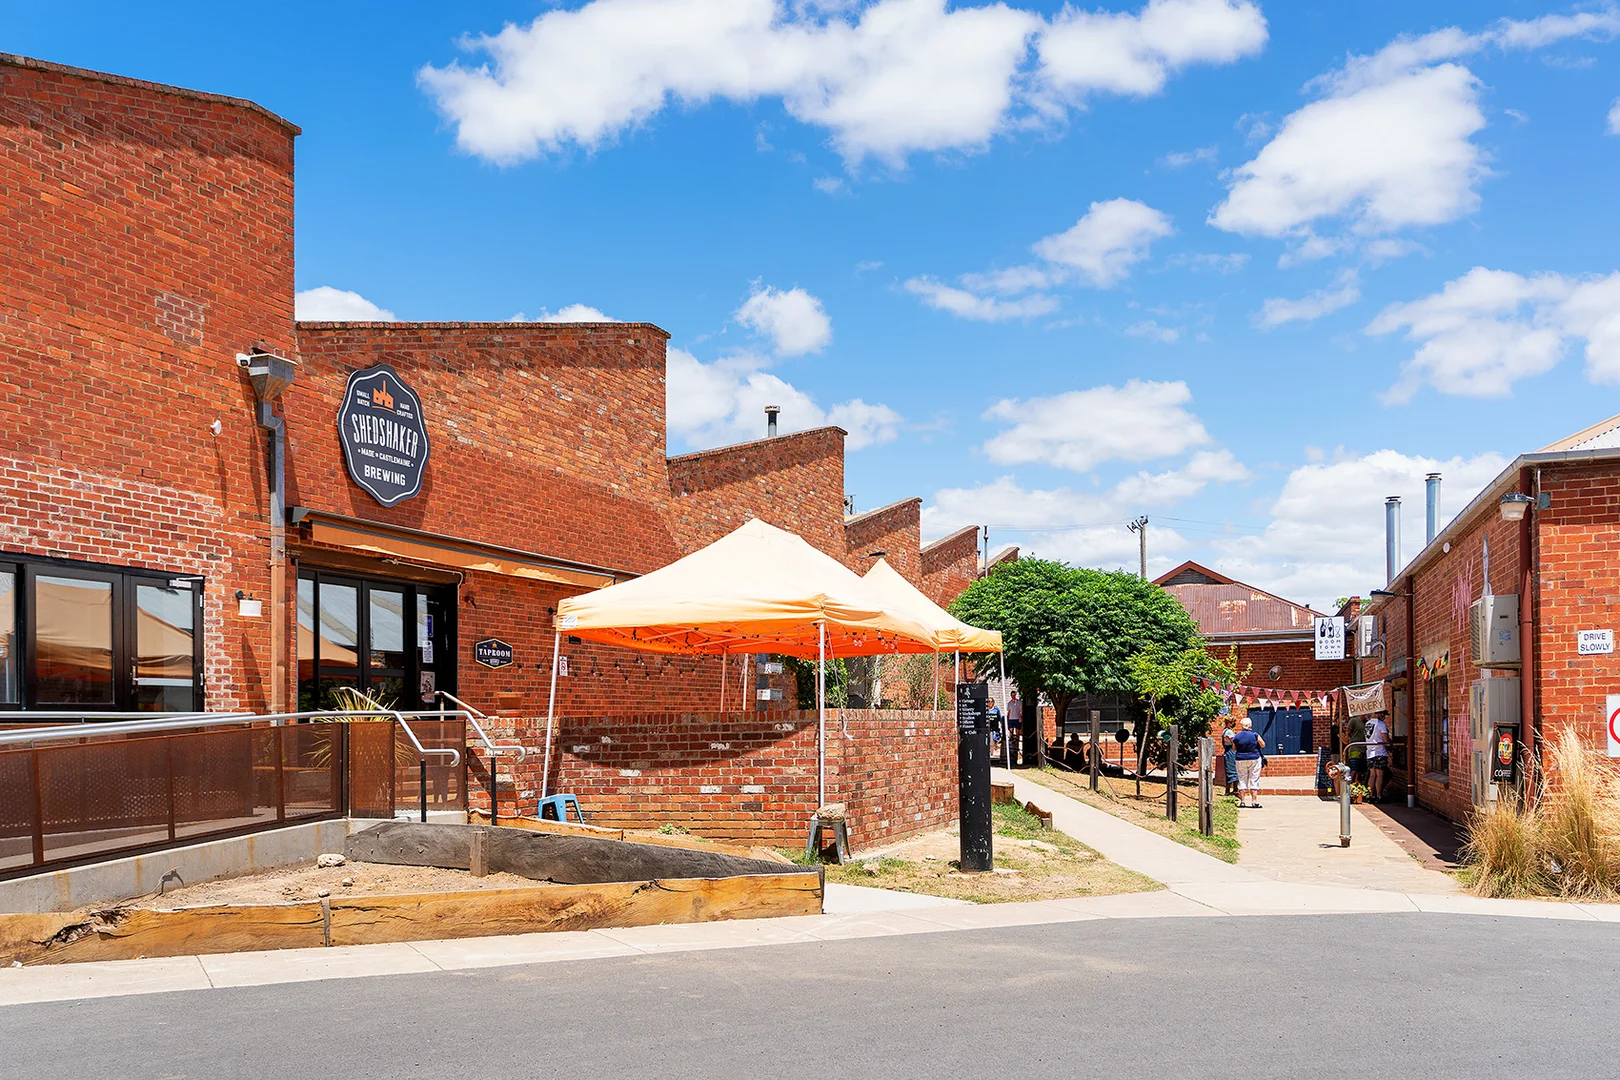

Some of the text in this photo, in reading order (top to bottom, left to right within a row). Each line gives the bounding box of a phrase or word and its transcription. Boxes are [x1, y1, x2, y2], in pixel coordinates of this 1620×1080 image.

[356, 390, 370, 399] SMALL
[357, 398, 370, 407] BATCH
[397, 410, 413, 419] CRAFTED
[351, 413, 419, 459] SHEDSHAKER
[361, 447, 411, 468] MADE CASTLEMAINE
[364, 465, 406, 486] BREWING
[479, 649, 510, 657] TAPROOM
[1349, 699, 1384, 713] BAKERY
